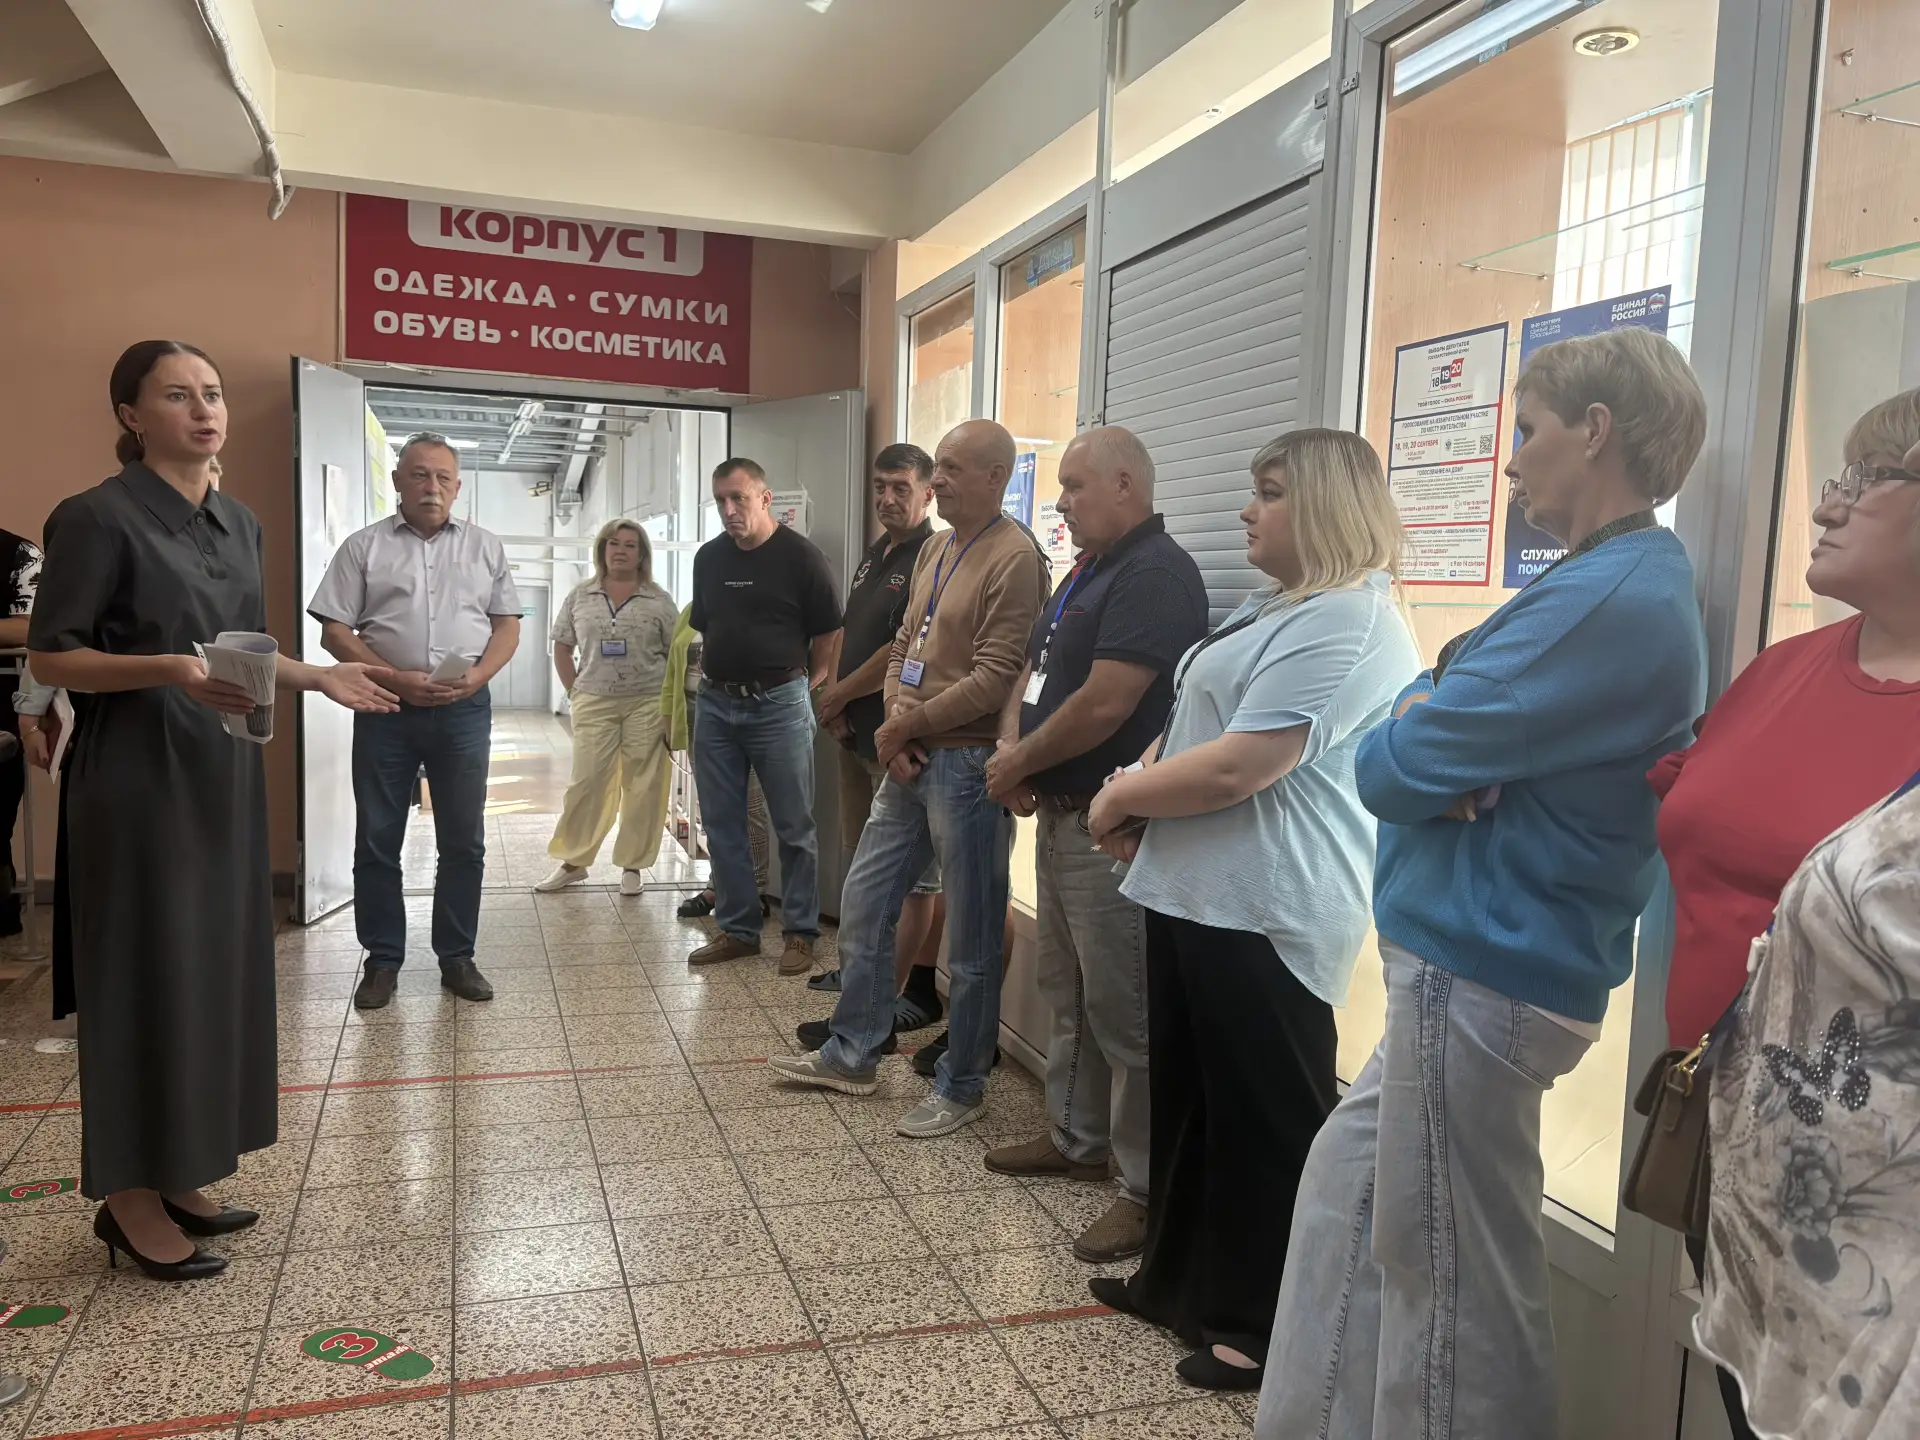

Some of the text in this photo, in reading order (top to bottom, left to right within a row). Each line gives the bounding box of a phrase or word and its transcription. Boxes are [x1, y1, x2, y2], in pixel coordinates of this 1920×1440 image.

[657, 226, 677, 263] 1
[373, 267, 728, 326] ОДЕЖДА СУМКИ
[1612, 298, 1647, 313] ЕДИНАЯ
[1611, 307, 1646, 322] РОССИЯ
[373, 310, 727, 366] ОБУВЬ КОСМЕТИКА
[1451, 362, 1462, 373] 20
[1432, 377, 1440, 387] 18
[1441, 370, 1450, 381] 19
[1521, 549, 1569, 560] СЛУЖИТ
[10, 1181, 61, 1199] 3
[319, 1332, 379, 1359] 3
